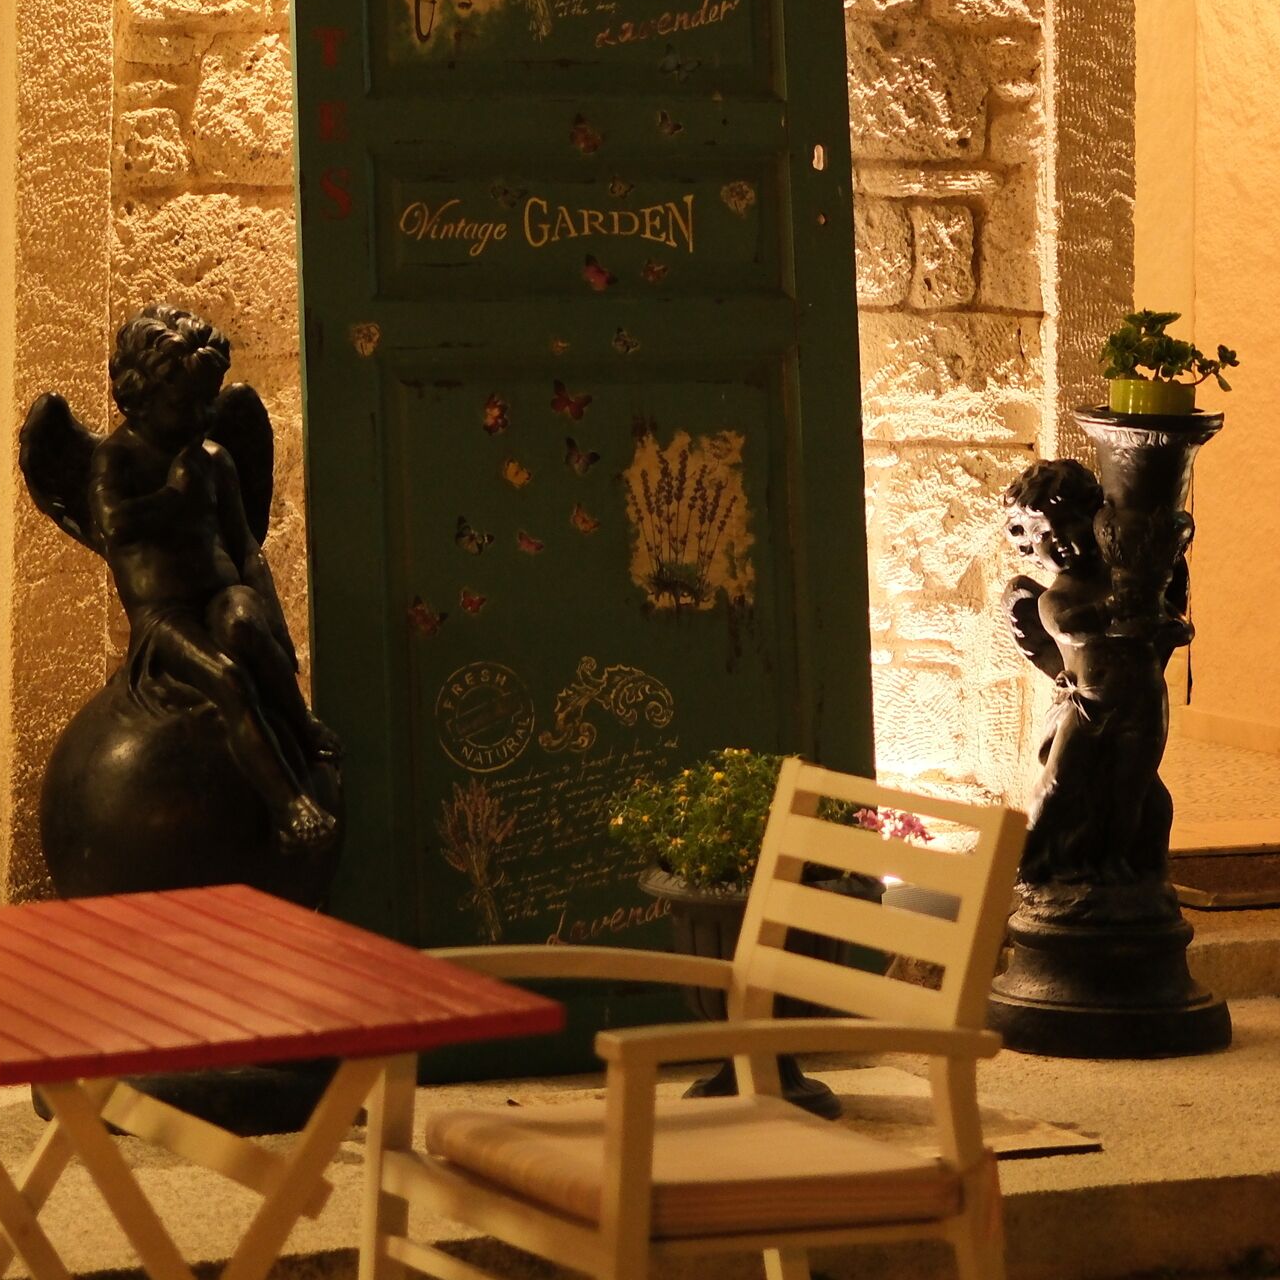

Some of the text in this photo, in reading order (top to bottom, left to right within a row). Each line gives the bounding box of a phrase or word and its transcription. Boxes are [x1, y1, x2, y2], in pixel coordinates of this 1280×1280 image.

[399, 193, 695, 257] Vintage GARDEN
[443, 668, 508, 711] FRESH
[461, 717, 531, 765] NATURAL
